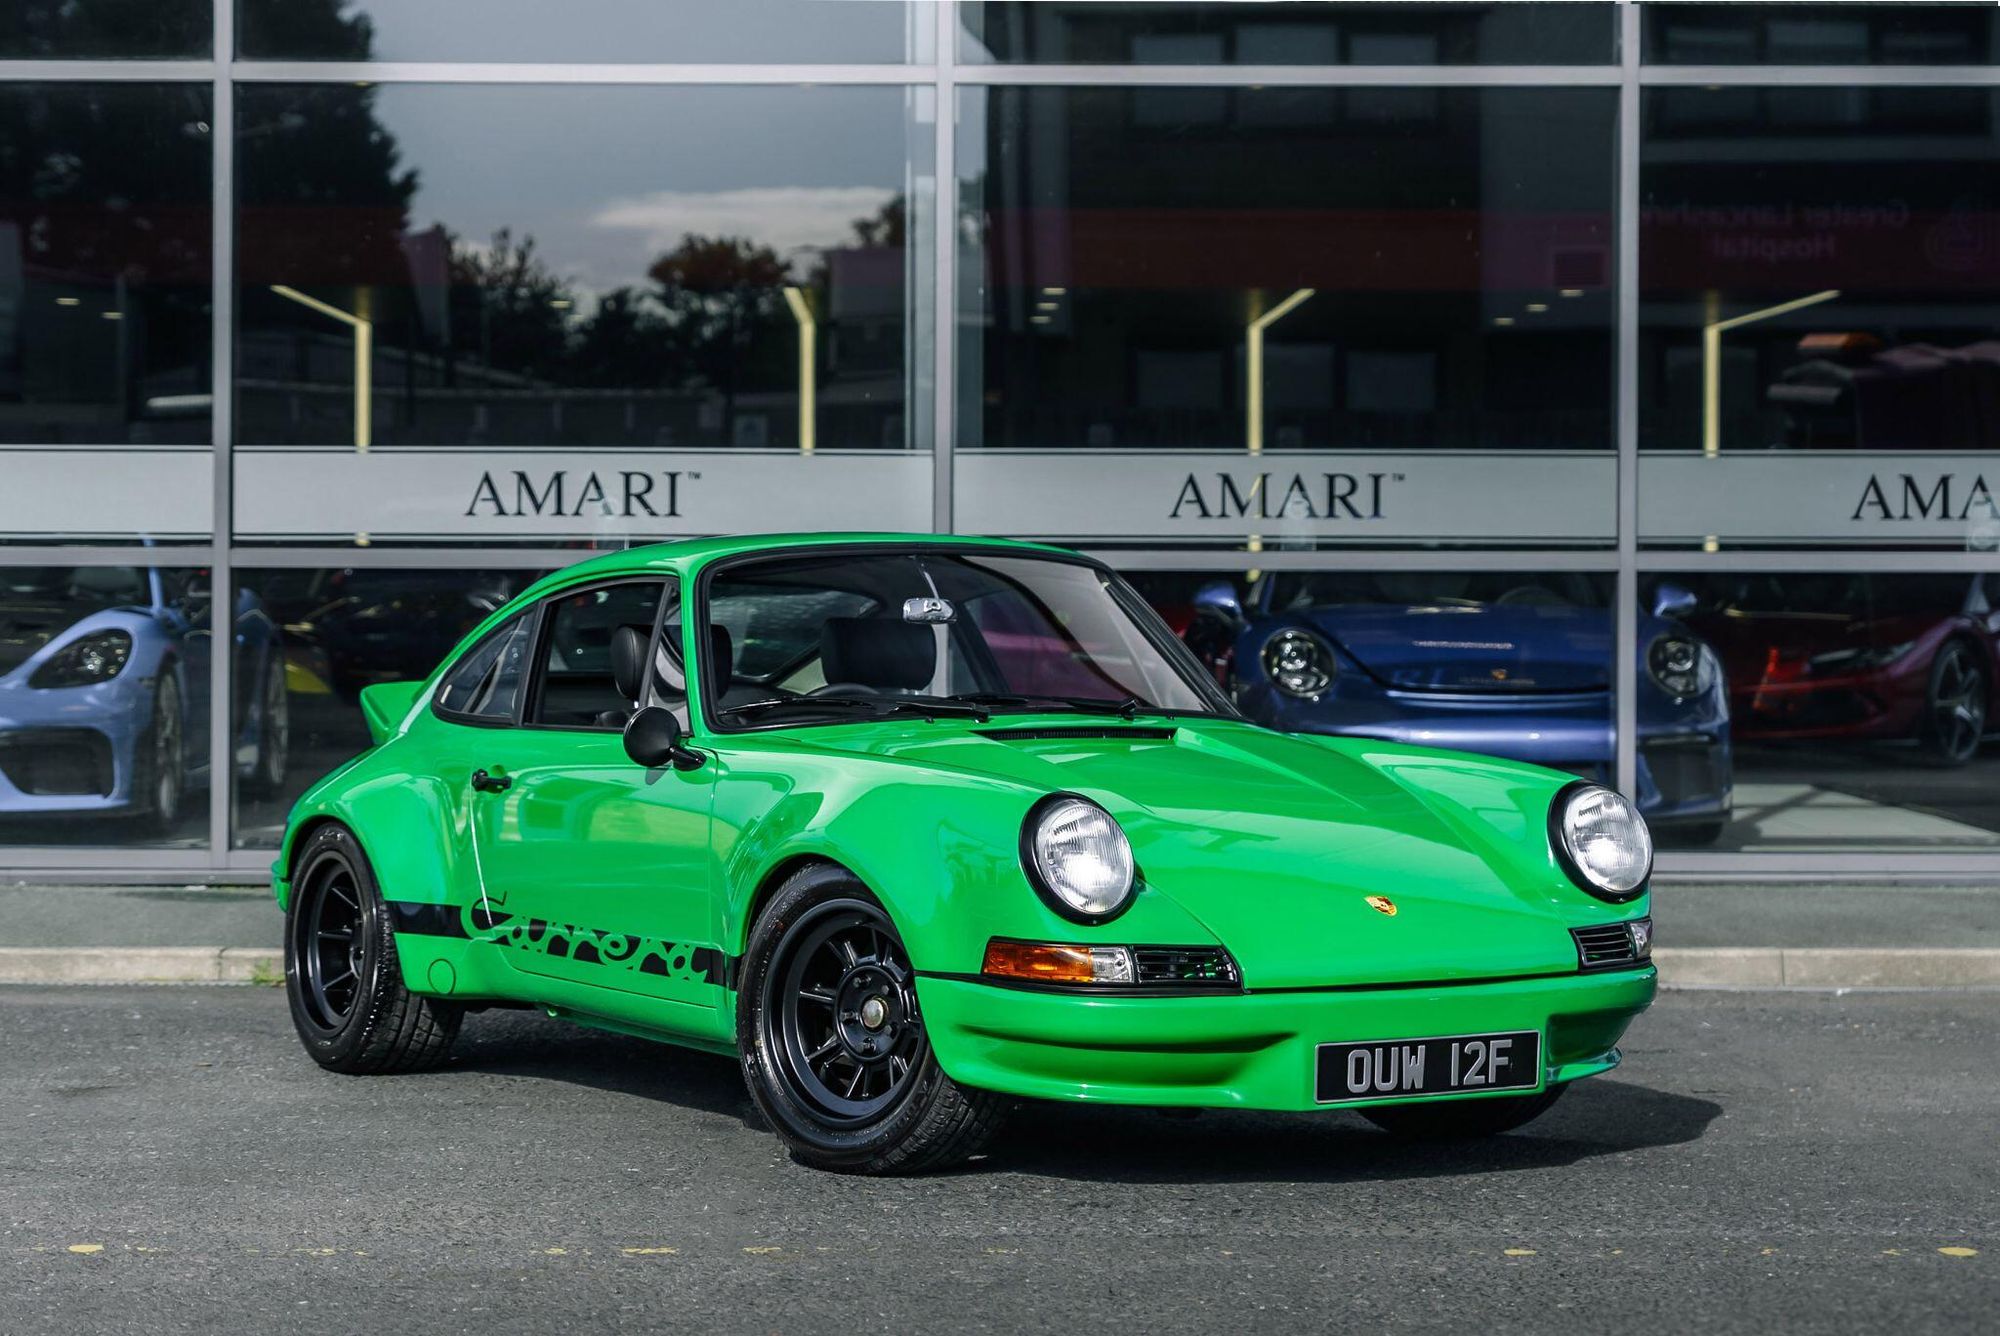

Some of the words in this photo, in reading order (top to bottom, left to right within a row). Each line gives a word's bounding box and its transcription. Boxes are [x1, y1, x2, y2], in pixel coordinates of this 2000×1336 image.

[464, 470, 683, 517] AMARI
[1168, 472, 1387, 519] AMARI
[459, 890, 708, 982] Carrera
[1347, 1045, 1425, 1094] OUW
[1451, 1039, 1513, 1087] 12F
